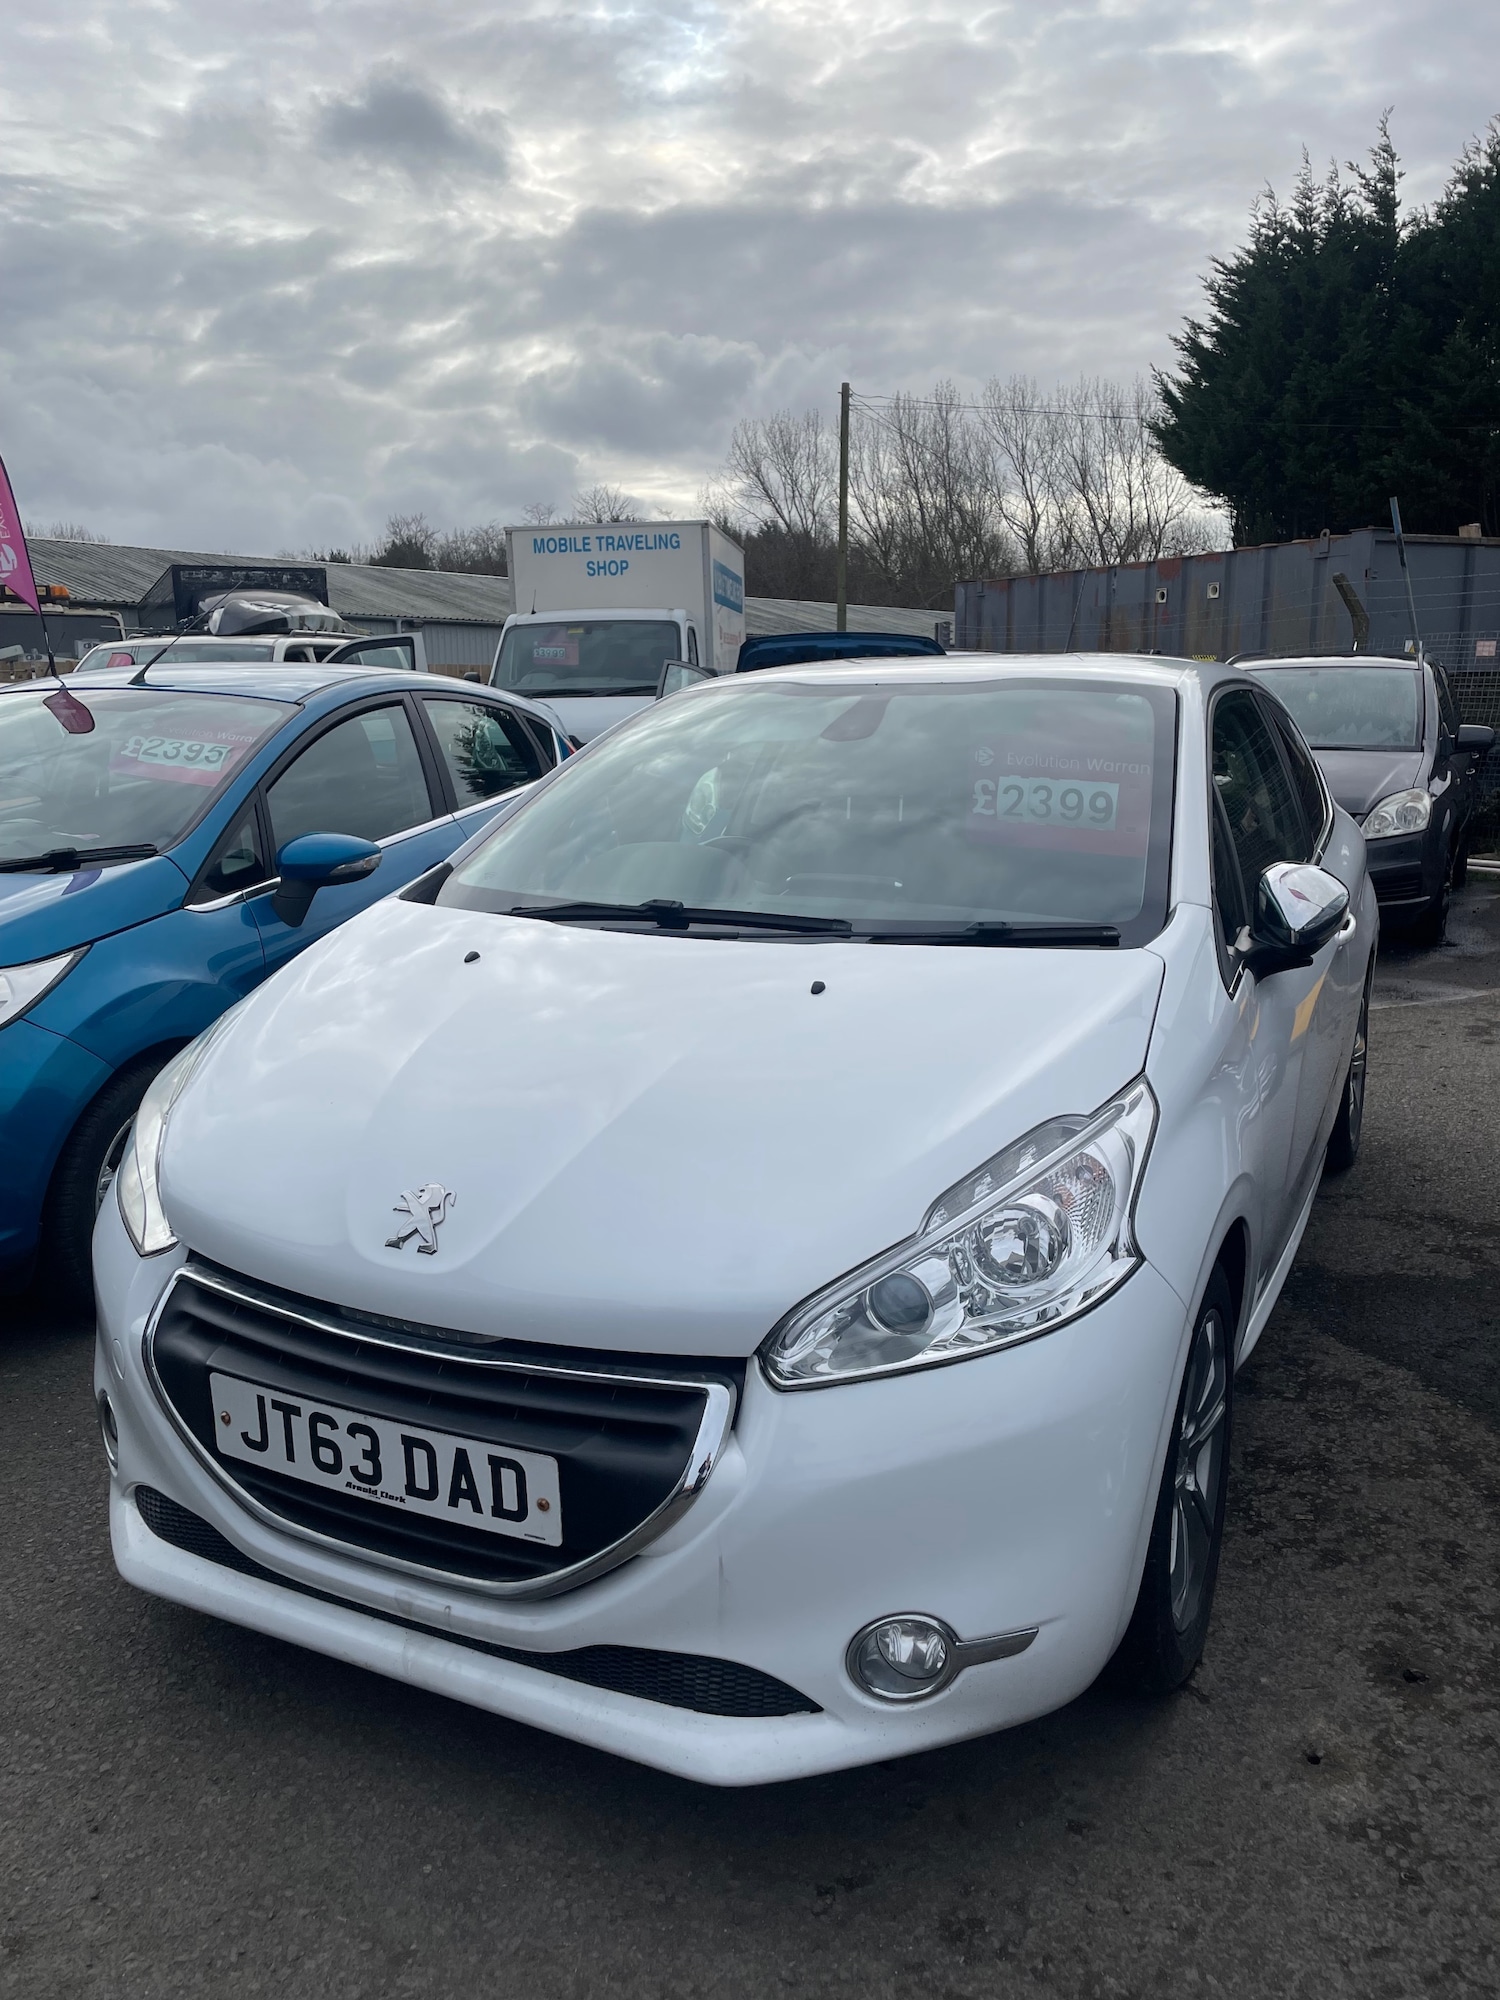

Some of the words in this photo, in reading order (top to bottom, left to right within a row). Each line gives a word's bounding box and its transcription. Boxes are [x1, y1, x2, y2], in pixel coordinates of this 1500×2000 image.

[533, 536, 591, 554] MOBILE
[596, 533, 681, 551] TRAVELING
[586, 560, 629, 577] SHOP
[121, 735, 229, 764] £2395
[1007, 752, 1080, 770] Evolution
[972, 778, 1114, 824] £2399
[241, 1394, 383, 1487] JT63
[400, 1434, 529, 1523] DAD
[346, 1481, 378, 1496] Arnold
[380, 1490, 406, 1504] Clark
